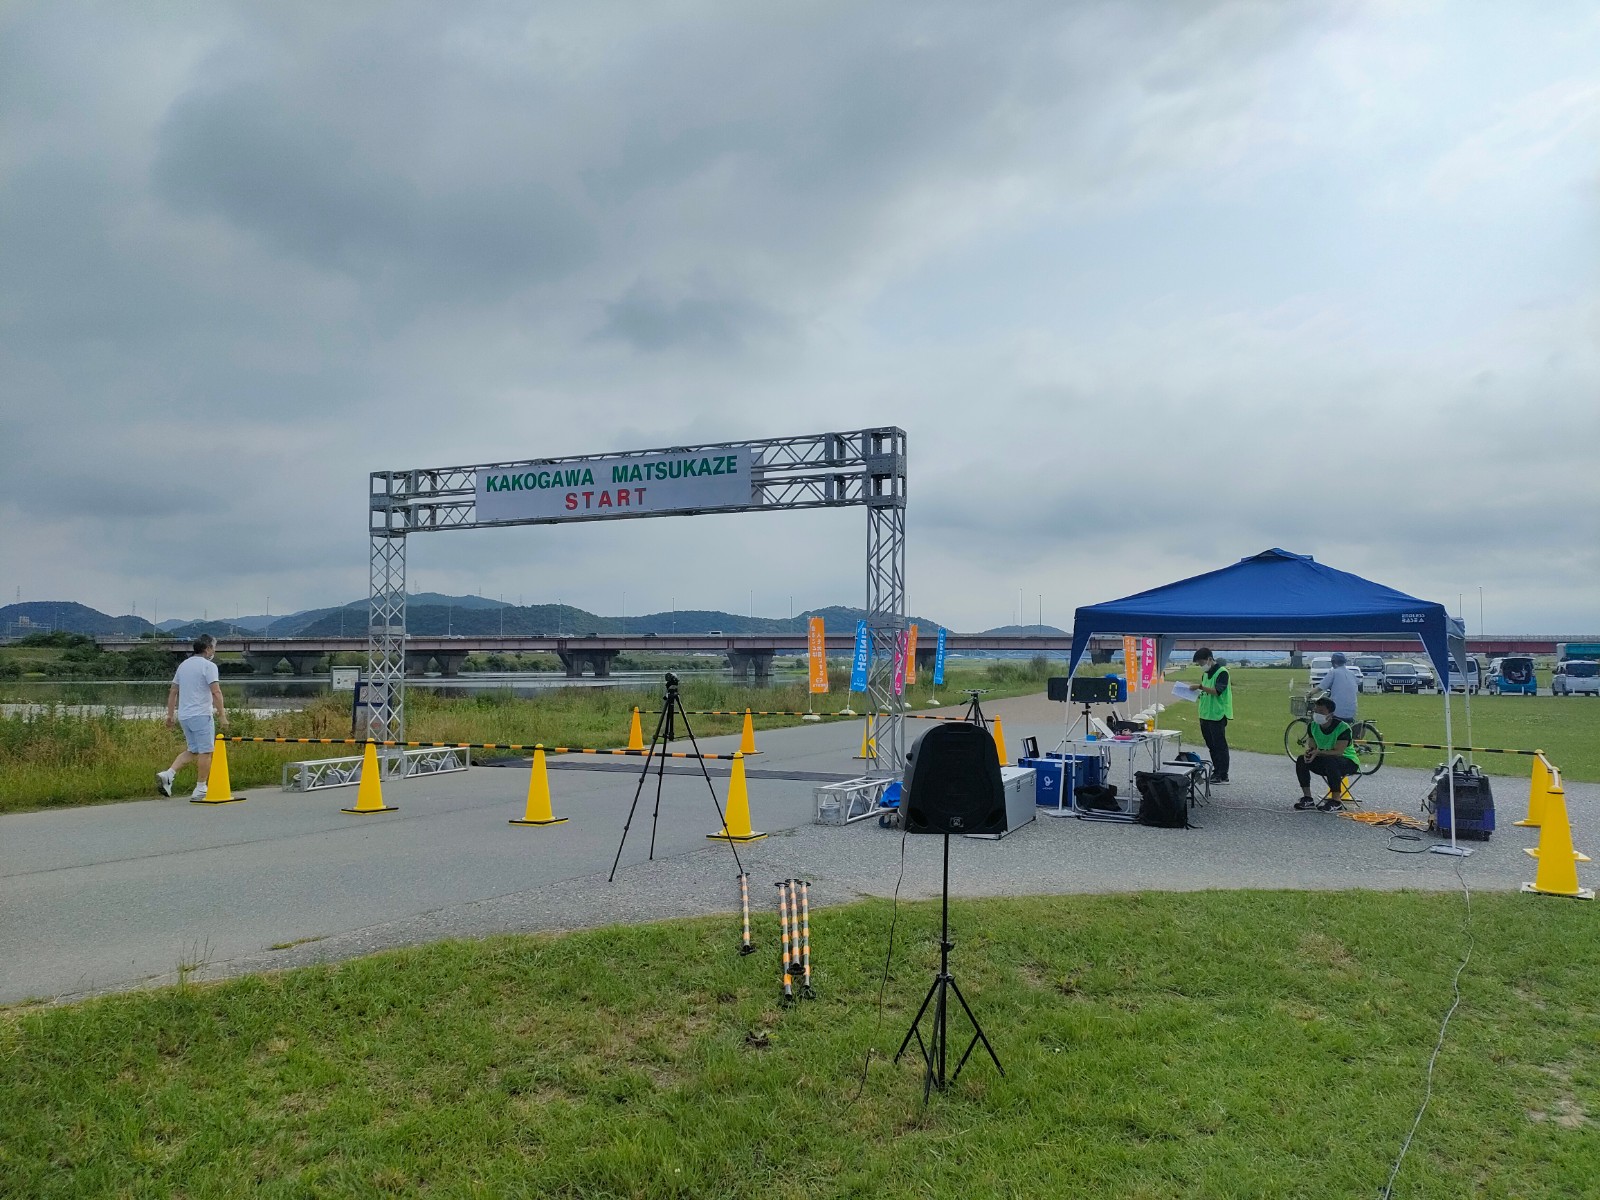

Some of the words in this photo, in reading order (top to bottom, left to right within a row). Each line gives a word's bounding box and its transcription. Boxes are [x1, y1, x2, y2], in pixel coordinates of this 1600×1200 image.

[486, 468, 595, 492] KAKOGAWA
[612, 455, 738, 483] MATSUKAZE
[565, 488, 647, 511] START
[1109, 682, 1118, 698] 0
